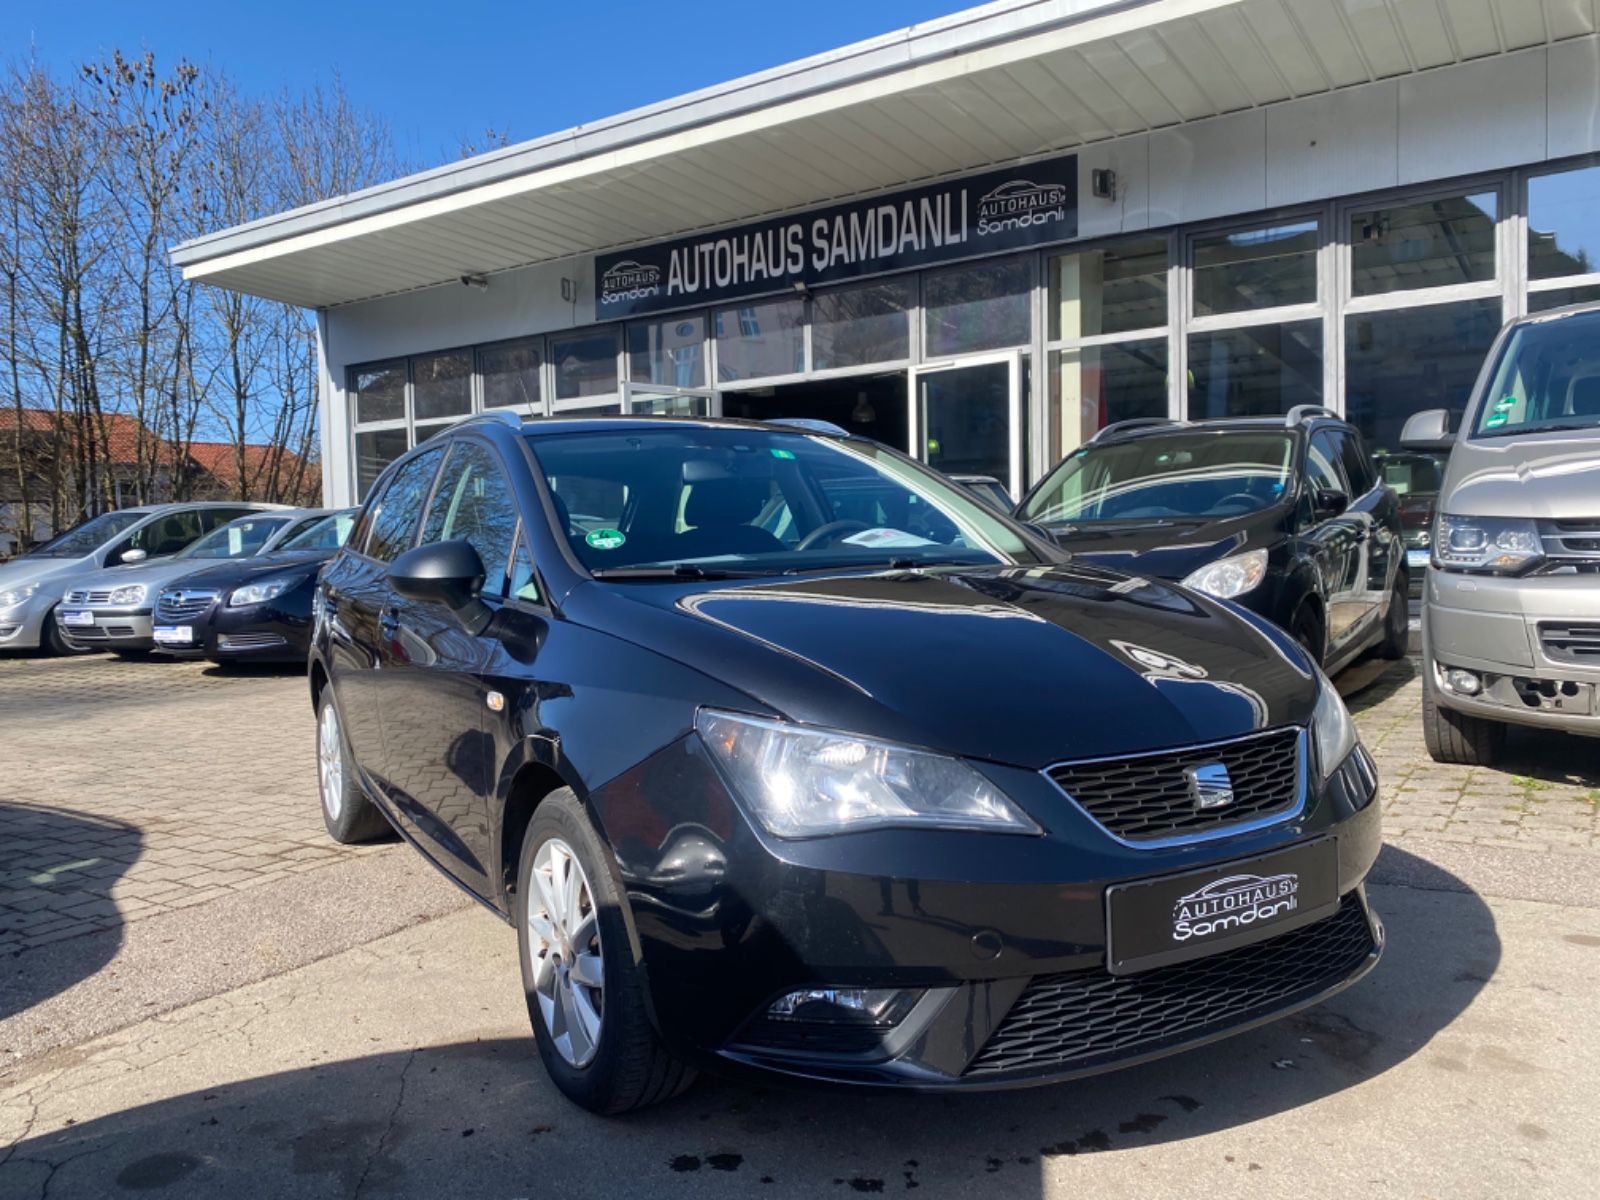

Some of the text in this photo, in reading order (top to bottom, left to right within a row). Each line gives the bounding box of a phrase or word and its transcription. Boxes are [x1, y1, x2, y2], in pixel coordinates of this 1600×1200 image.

[981, 191, 1058, 217] AUTOHAUS
[667, 223, 805, 296] AUTOHAUS
[1178, 880, 1290, 921] AUTOHAUS
